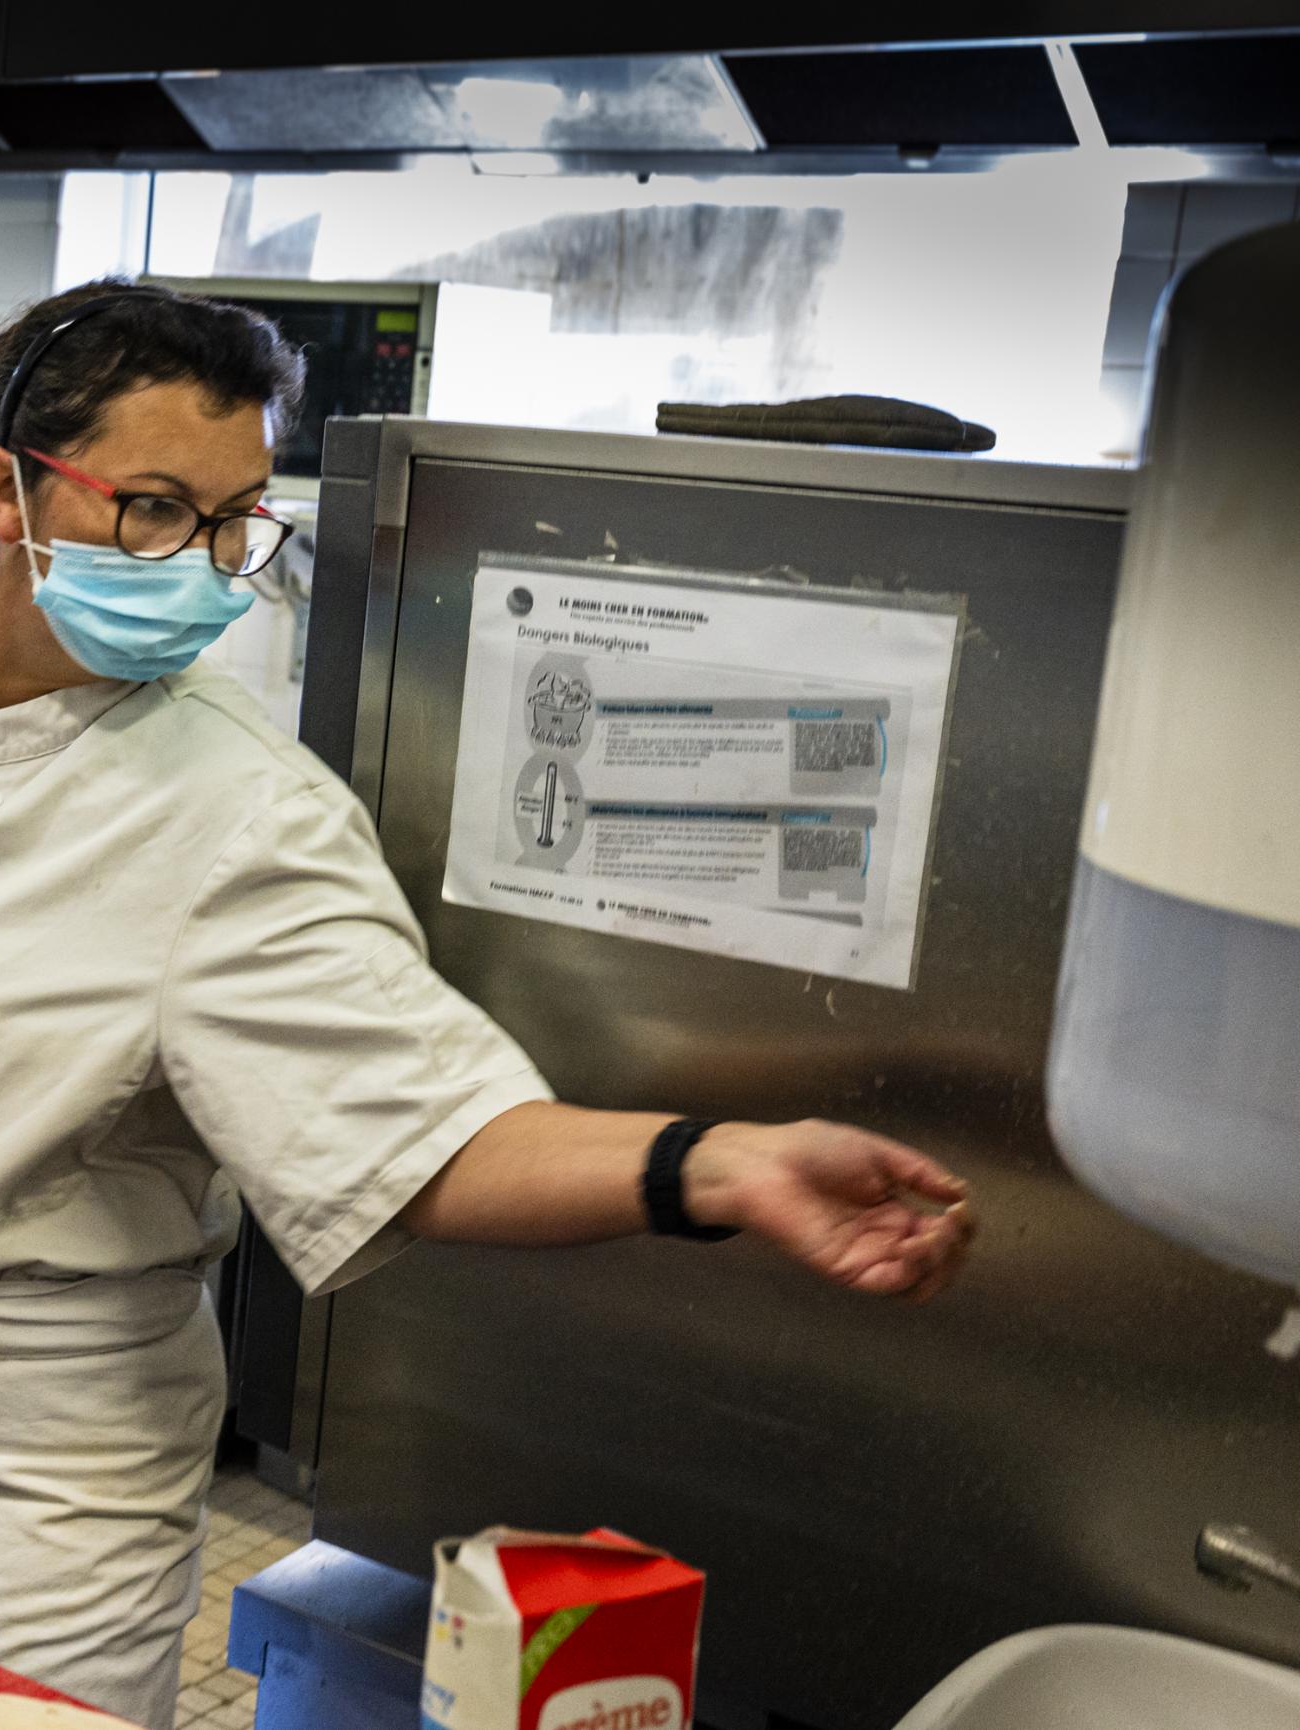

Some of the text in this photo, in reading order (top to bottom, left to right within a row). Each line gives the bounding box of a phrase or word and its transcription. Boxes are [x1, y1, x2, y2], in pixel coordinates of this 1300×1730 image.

[559, 597, 569, 609] LE
[572, 598, 601, 612] MOINS
[605, 602, 628, 615] CHER
[631, 605, 644, 617] EN
[517, 624, 649, 653] Dangers Biologiques
[490, 881, 528, 896] Formation
[554, 1696, 671, 1730] ème
